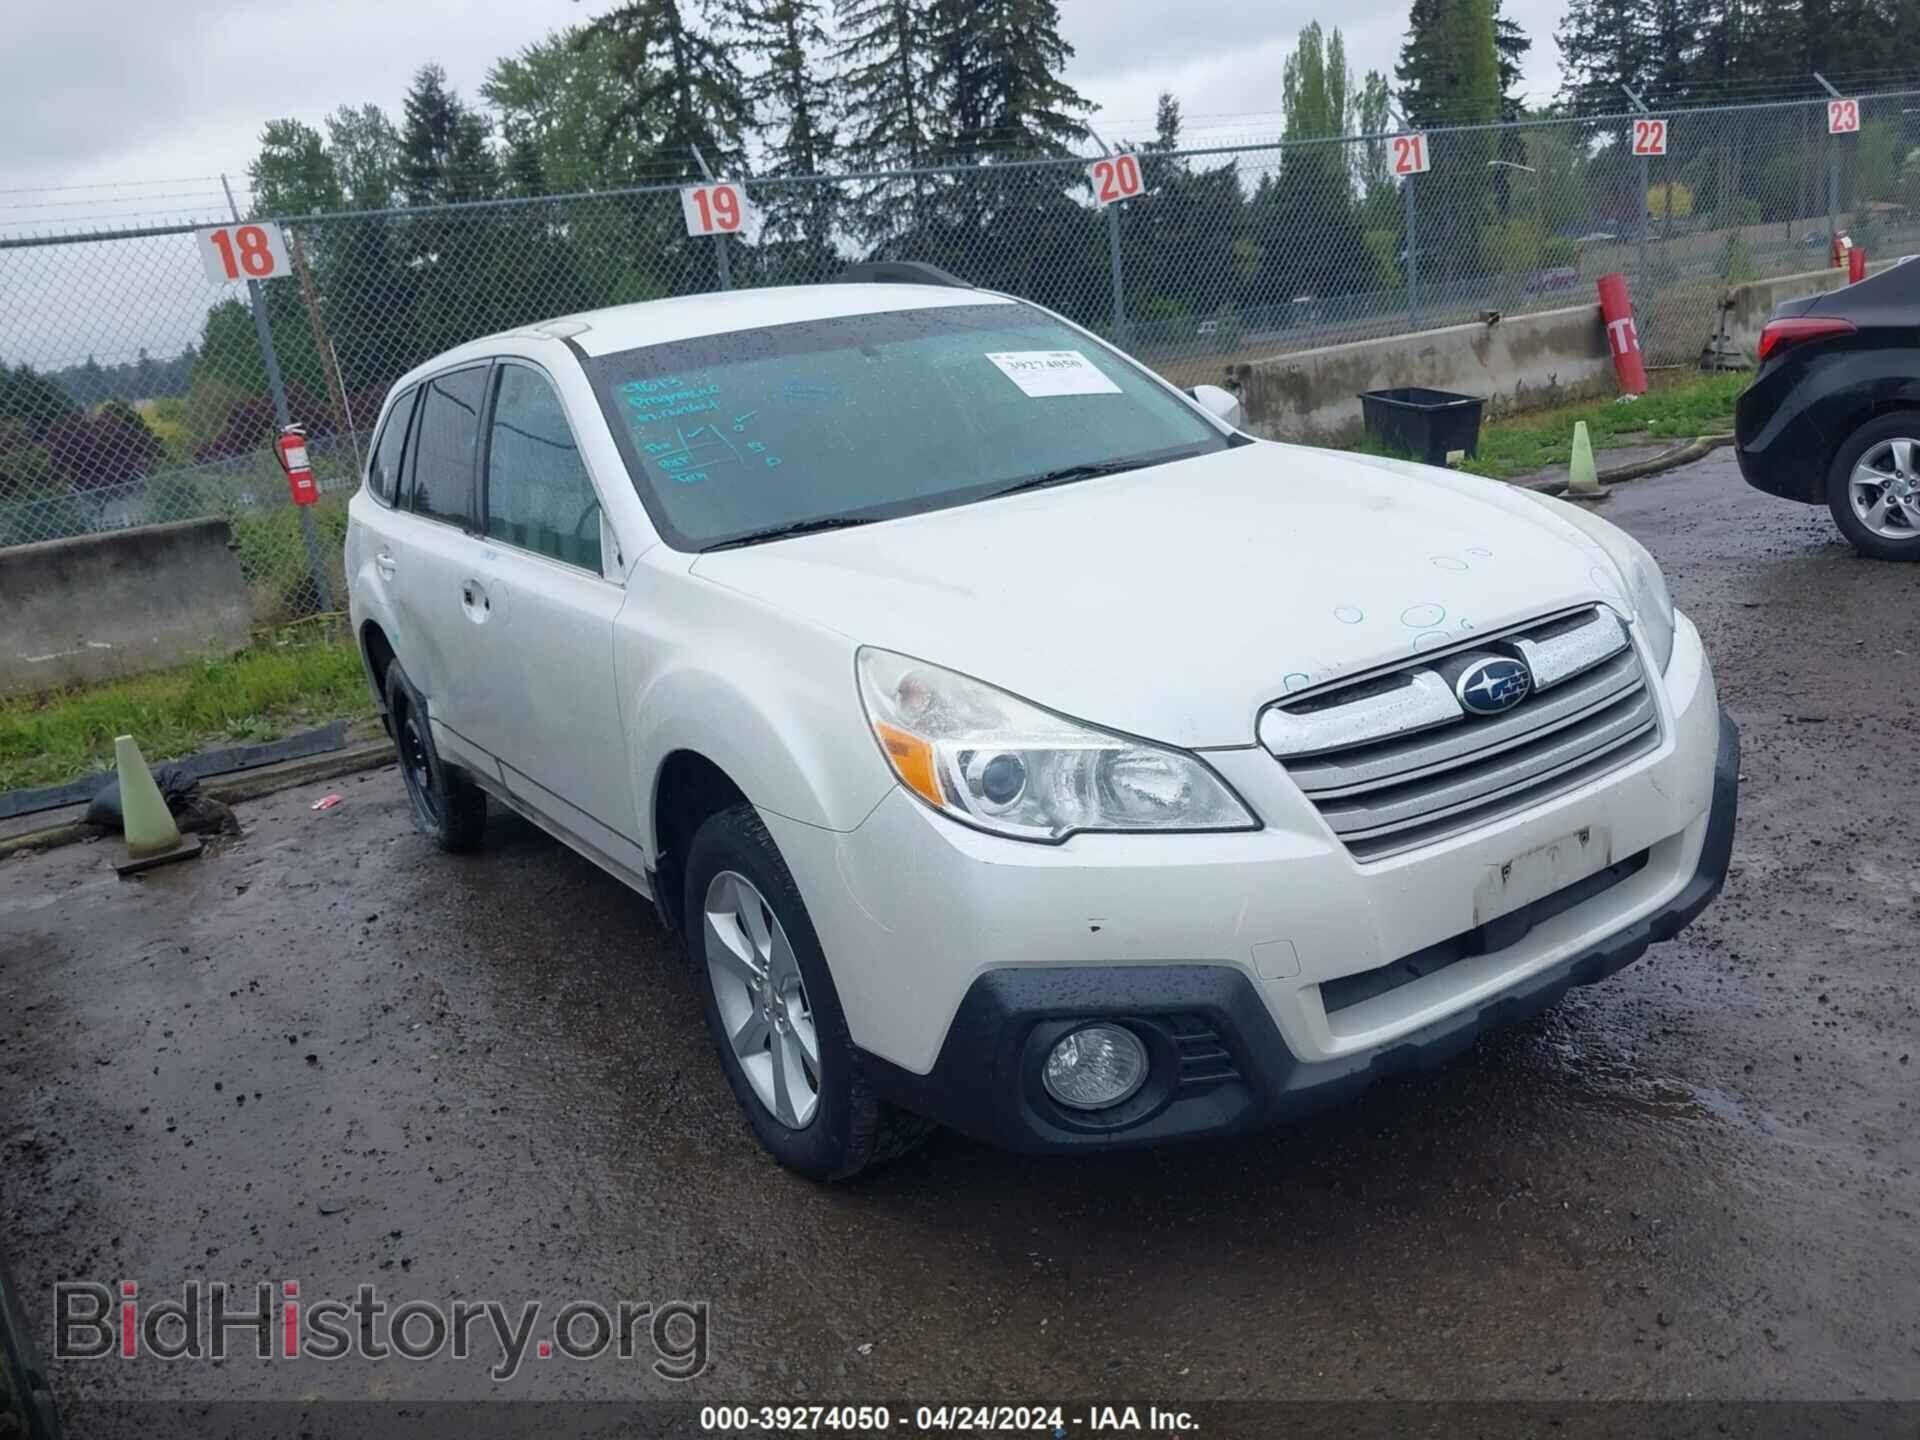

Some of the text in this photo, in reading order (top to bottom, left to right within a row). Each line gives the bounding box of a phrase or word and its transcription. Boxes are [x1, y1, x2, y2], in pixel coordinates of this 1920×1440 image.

[1832, 102, 1857, 131] 23
[1393, 136, 1423, 173] 21
[1635, 121, 1664, 154] 22
[1094, 156, 1138, 202] 20
[694, 185, 740, 231] 19
[210, 224, 274, 280] 18
